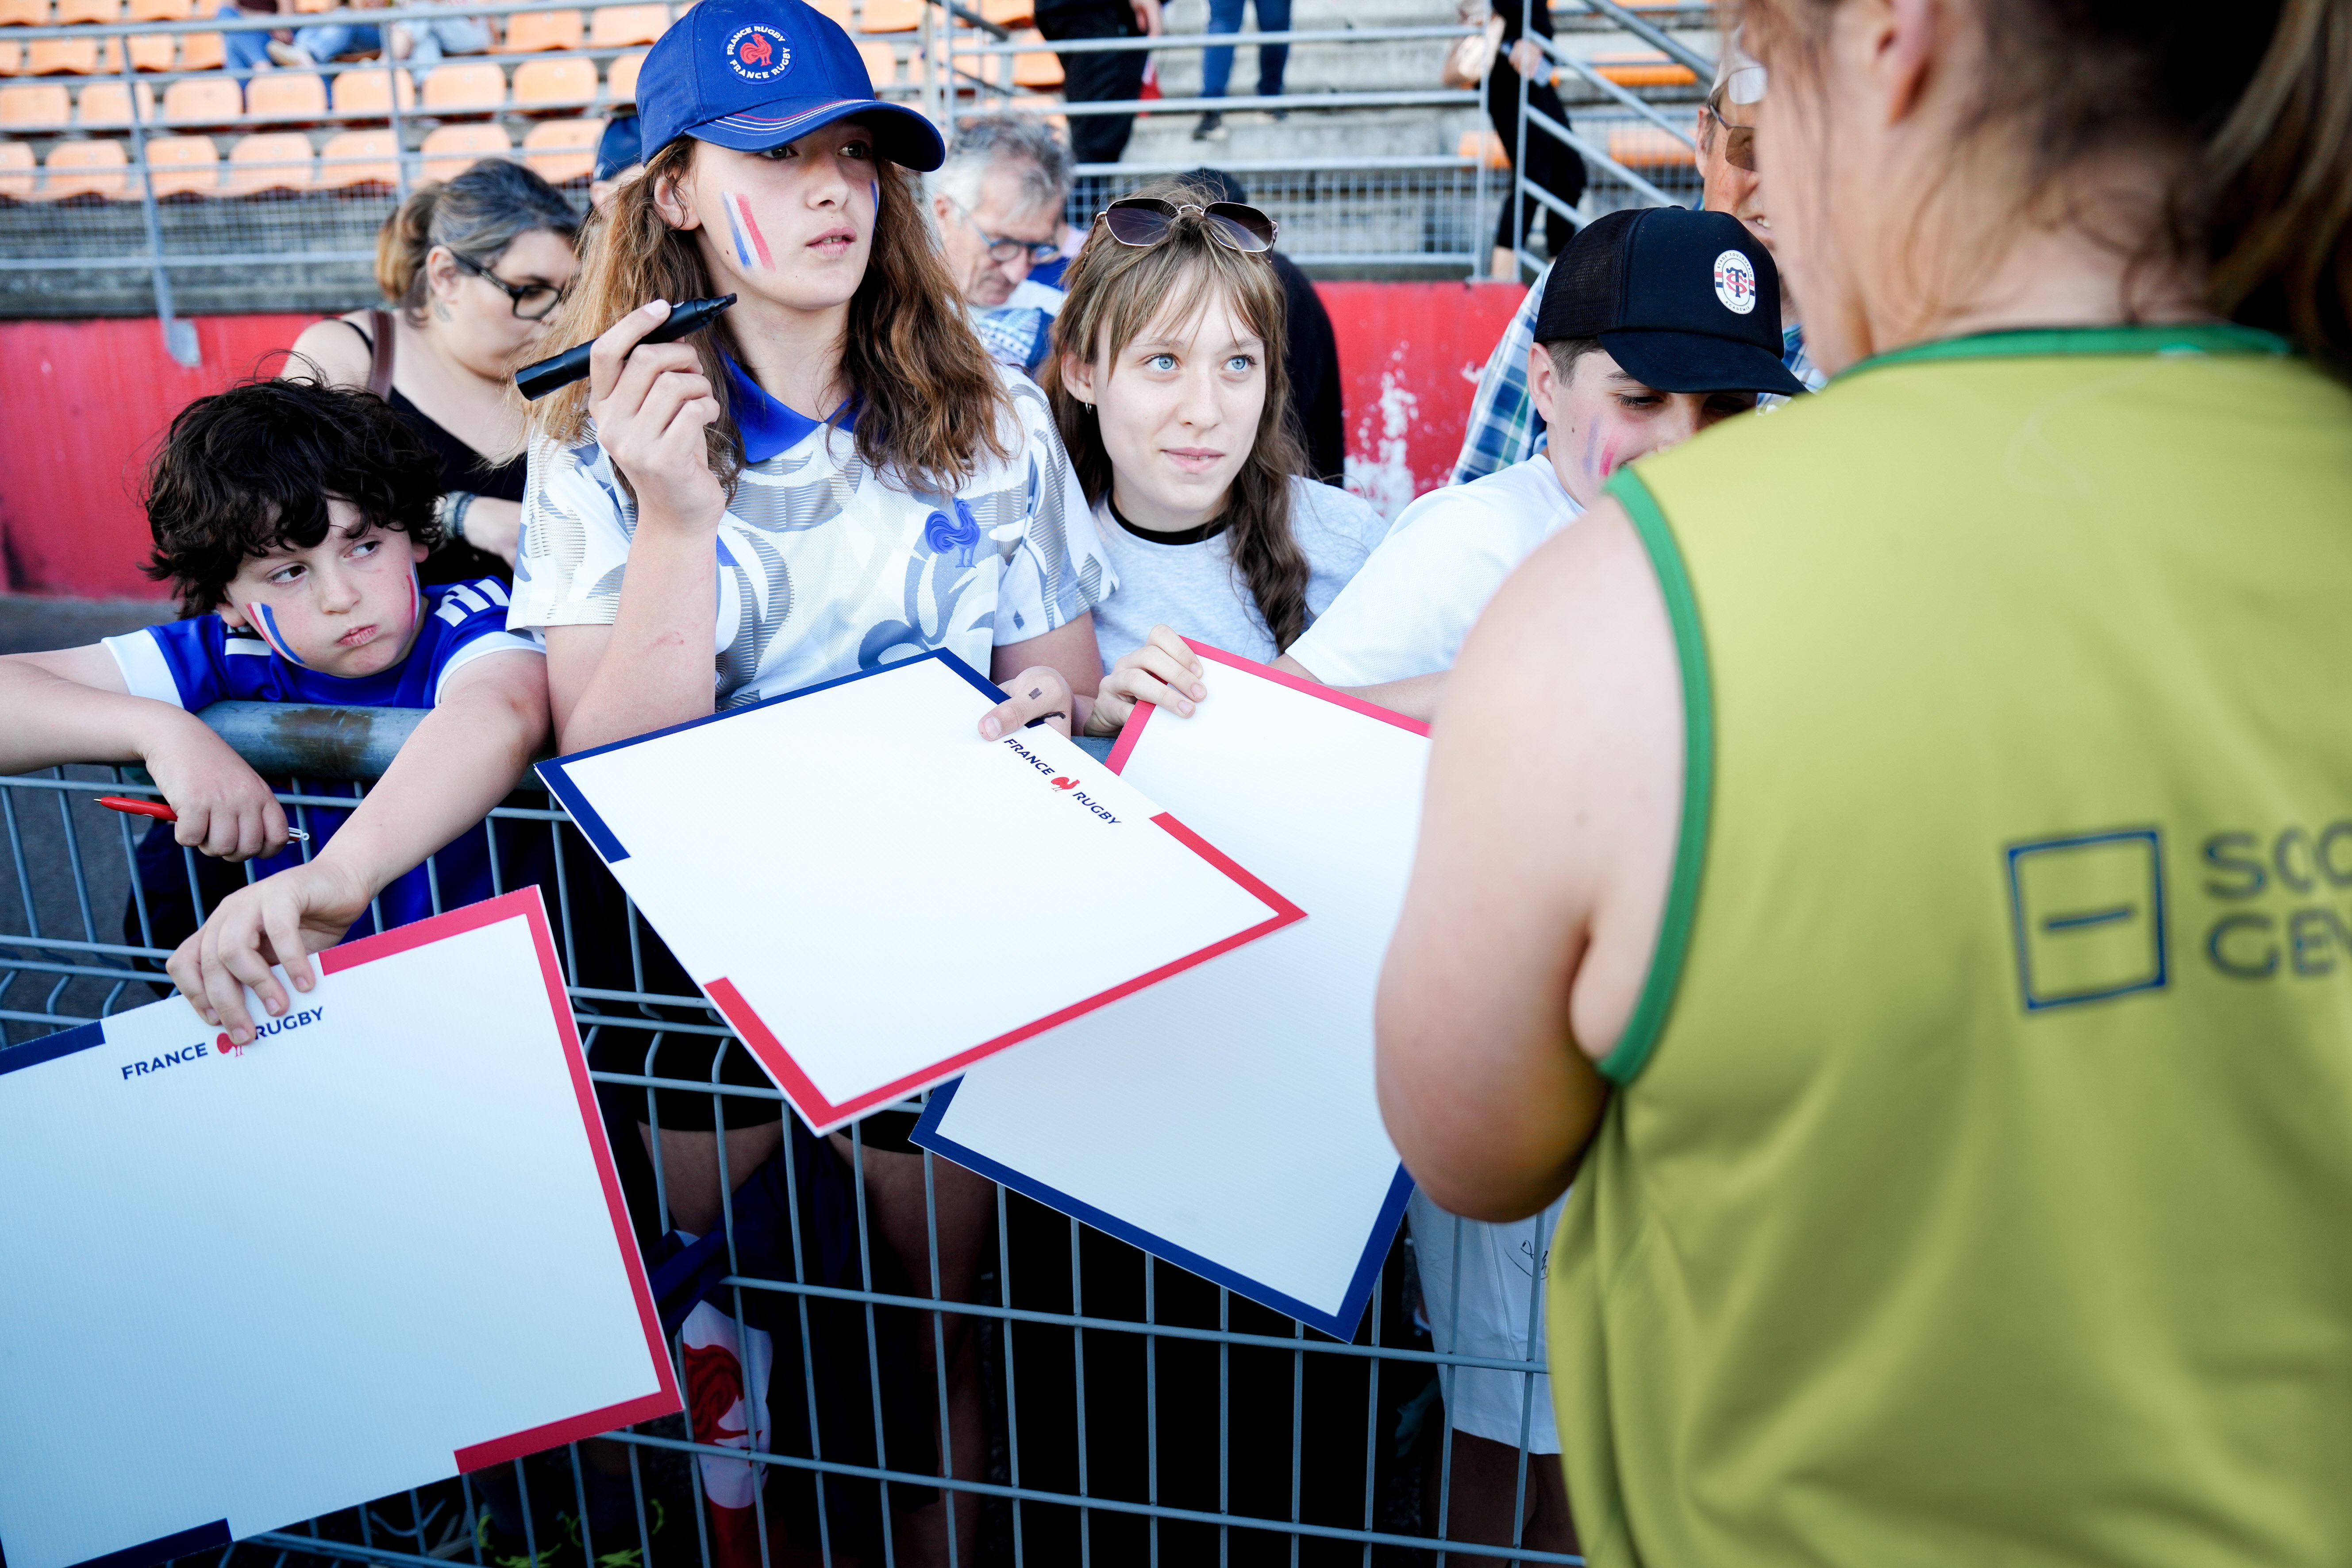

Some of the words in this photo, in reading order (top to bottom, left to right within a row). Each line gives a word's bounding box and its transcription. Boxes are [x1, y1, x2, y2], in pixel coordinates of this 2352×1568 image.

[727, 27, 753, 55] FRANCE
[754, 26, 785, 42] RUGBY
[730, 59, 770, 79] FRANCE
[770, 47, 791, 76] RUGBY
[1717, 254, 1728, 269] STADE
[1729, 253, 1753, 277] TOULOUSAIN
[1003, 738, 1055, 775] FRANCE
[1072, 791, 1122, 824] RUGBY
[121, 1042, 208, 1080] FRANCE
[255, 1006, 324, 1040] RUGBY
